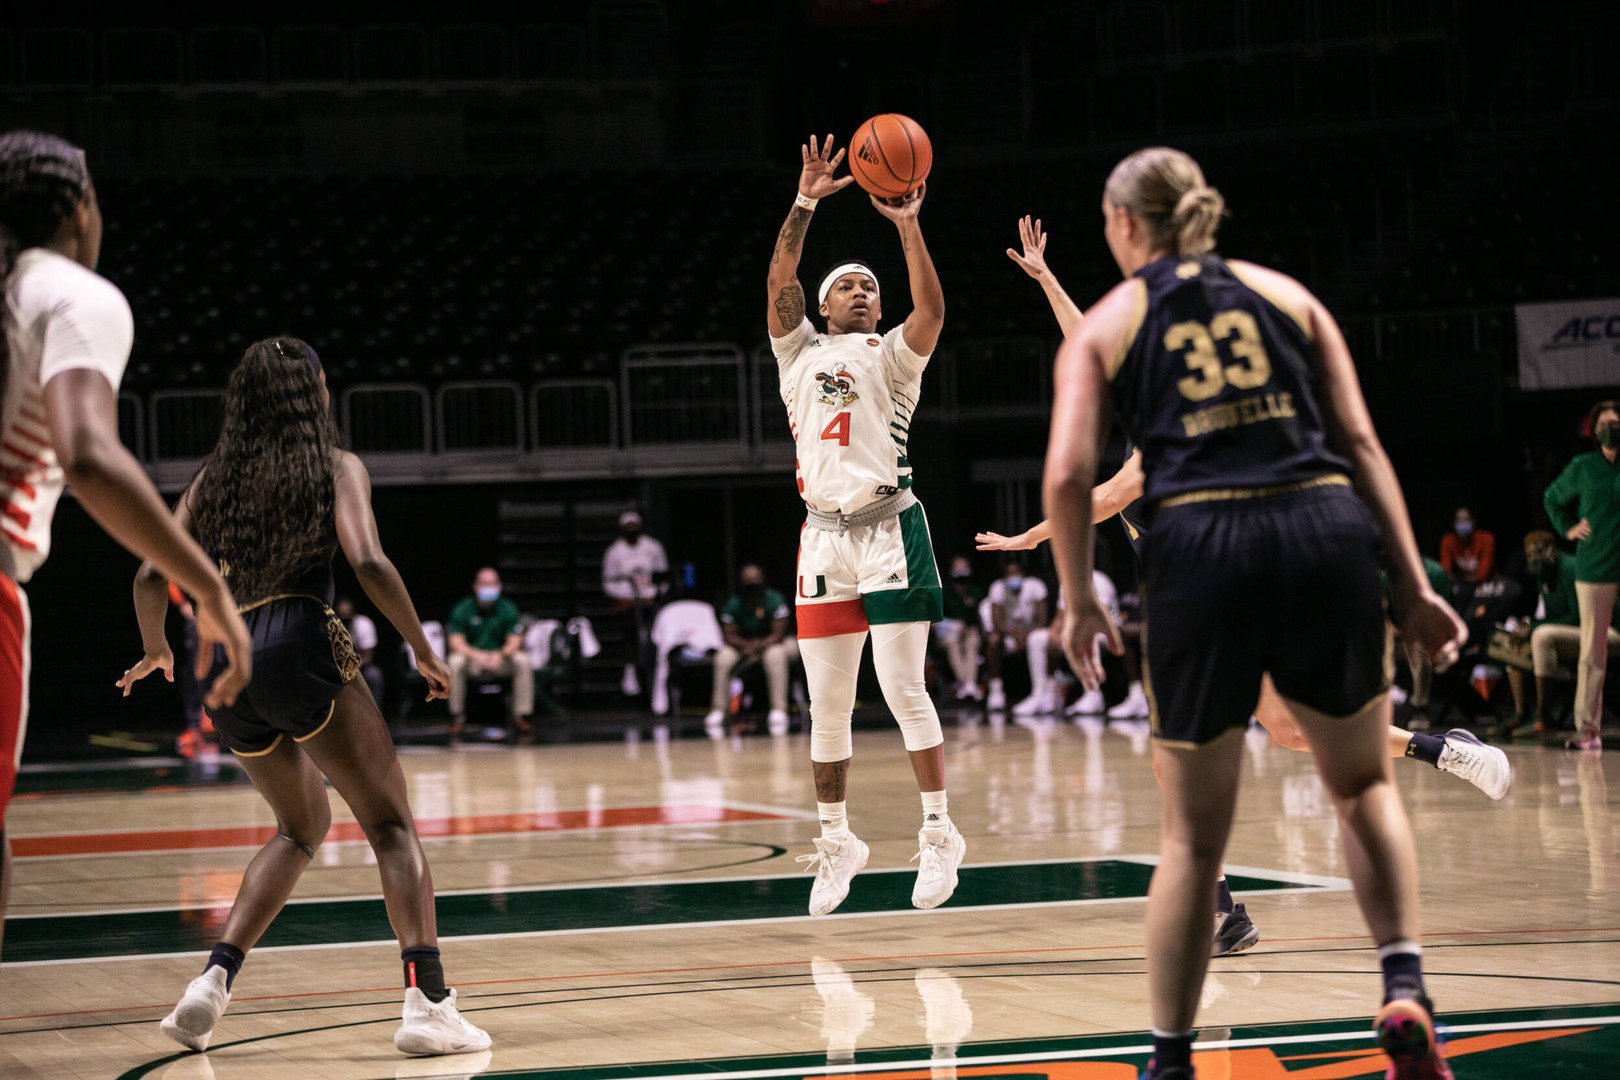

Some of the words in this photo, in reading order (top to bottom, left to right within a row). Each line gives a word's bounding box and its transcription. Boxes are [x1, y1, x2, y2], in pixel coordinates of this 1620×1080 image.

[1551, 315, 1620, 342] ACC
[1163, 309, 1273, 402] 33
[820, 411, 851, 446] 4
[799, 574, 827, 598] U
